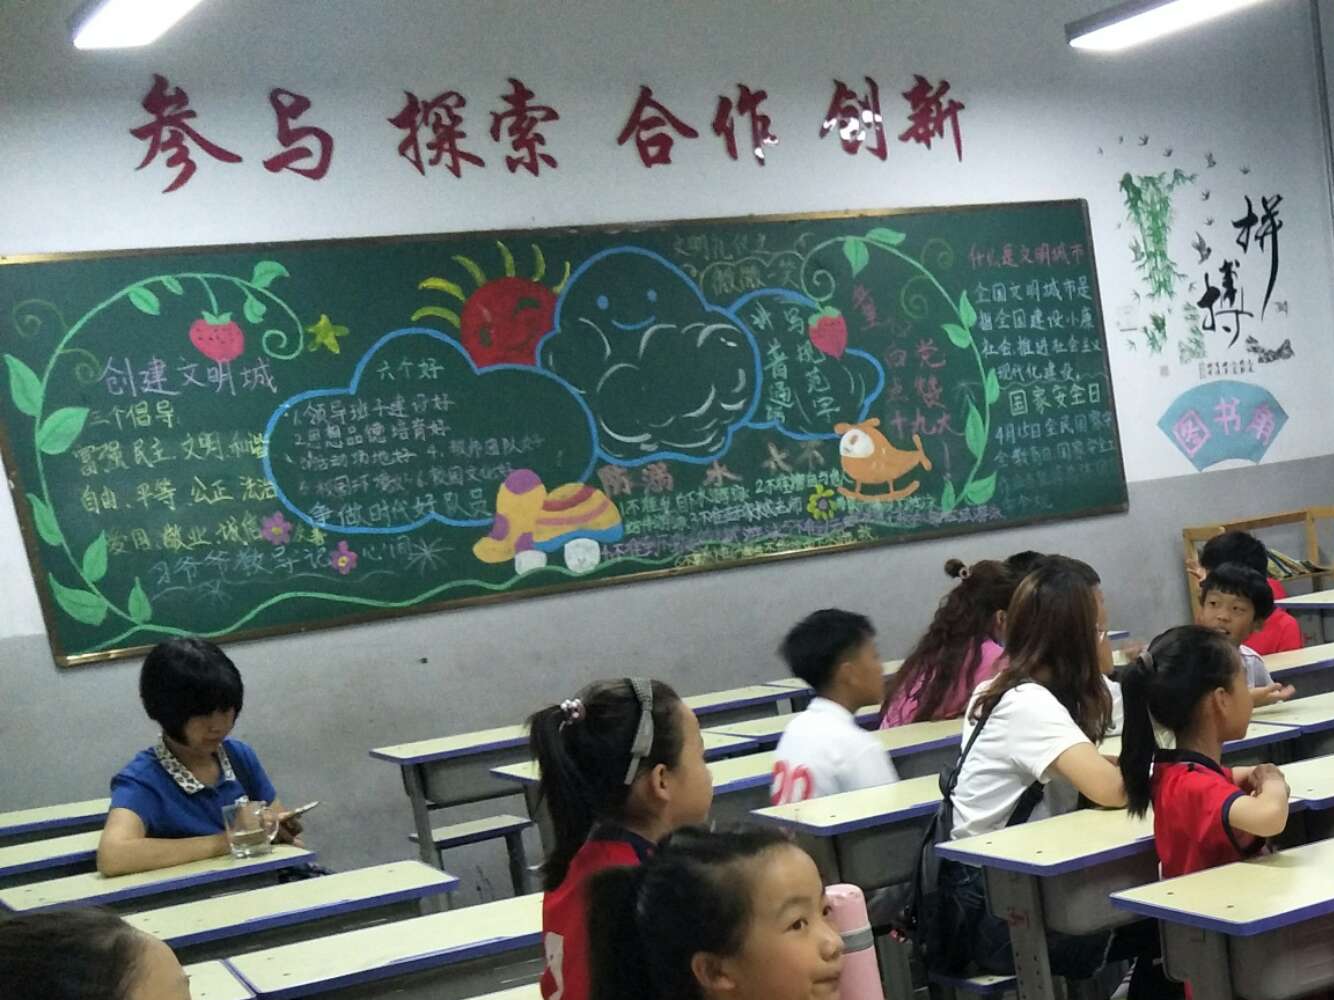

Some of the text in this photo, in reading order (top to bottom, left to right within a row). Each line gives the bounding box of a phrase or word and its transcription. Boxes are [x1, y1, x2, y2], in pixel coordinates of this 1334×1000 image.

[130, 73, 966, 194] 参与 探索 合作 创新
[376, 357, 445, 381] 六个好
[1009, 383, 1101, 416] 国家安全日
